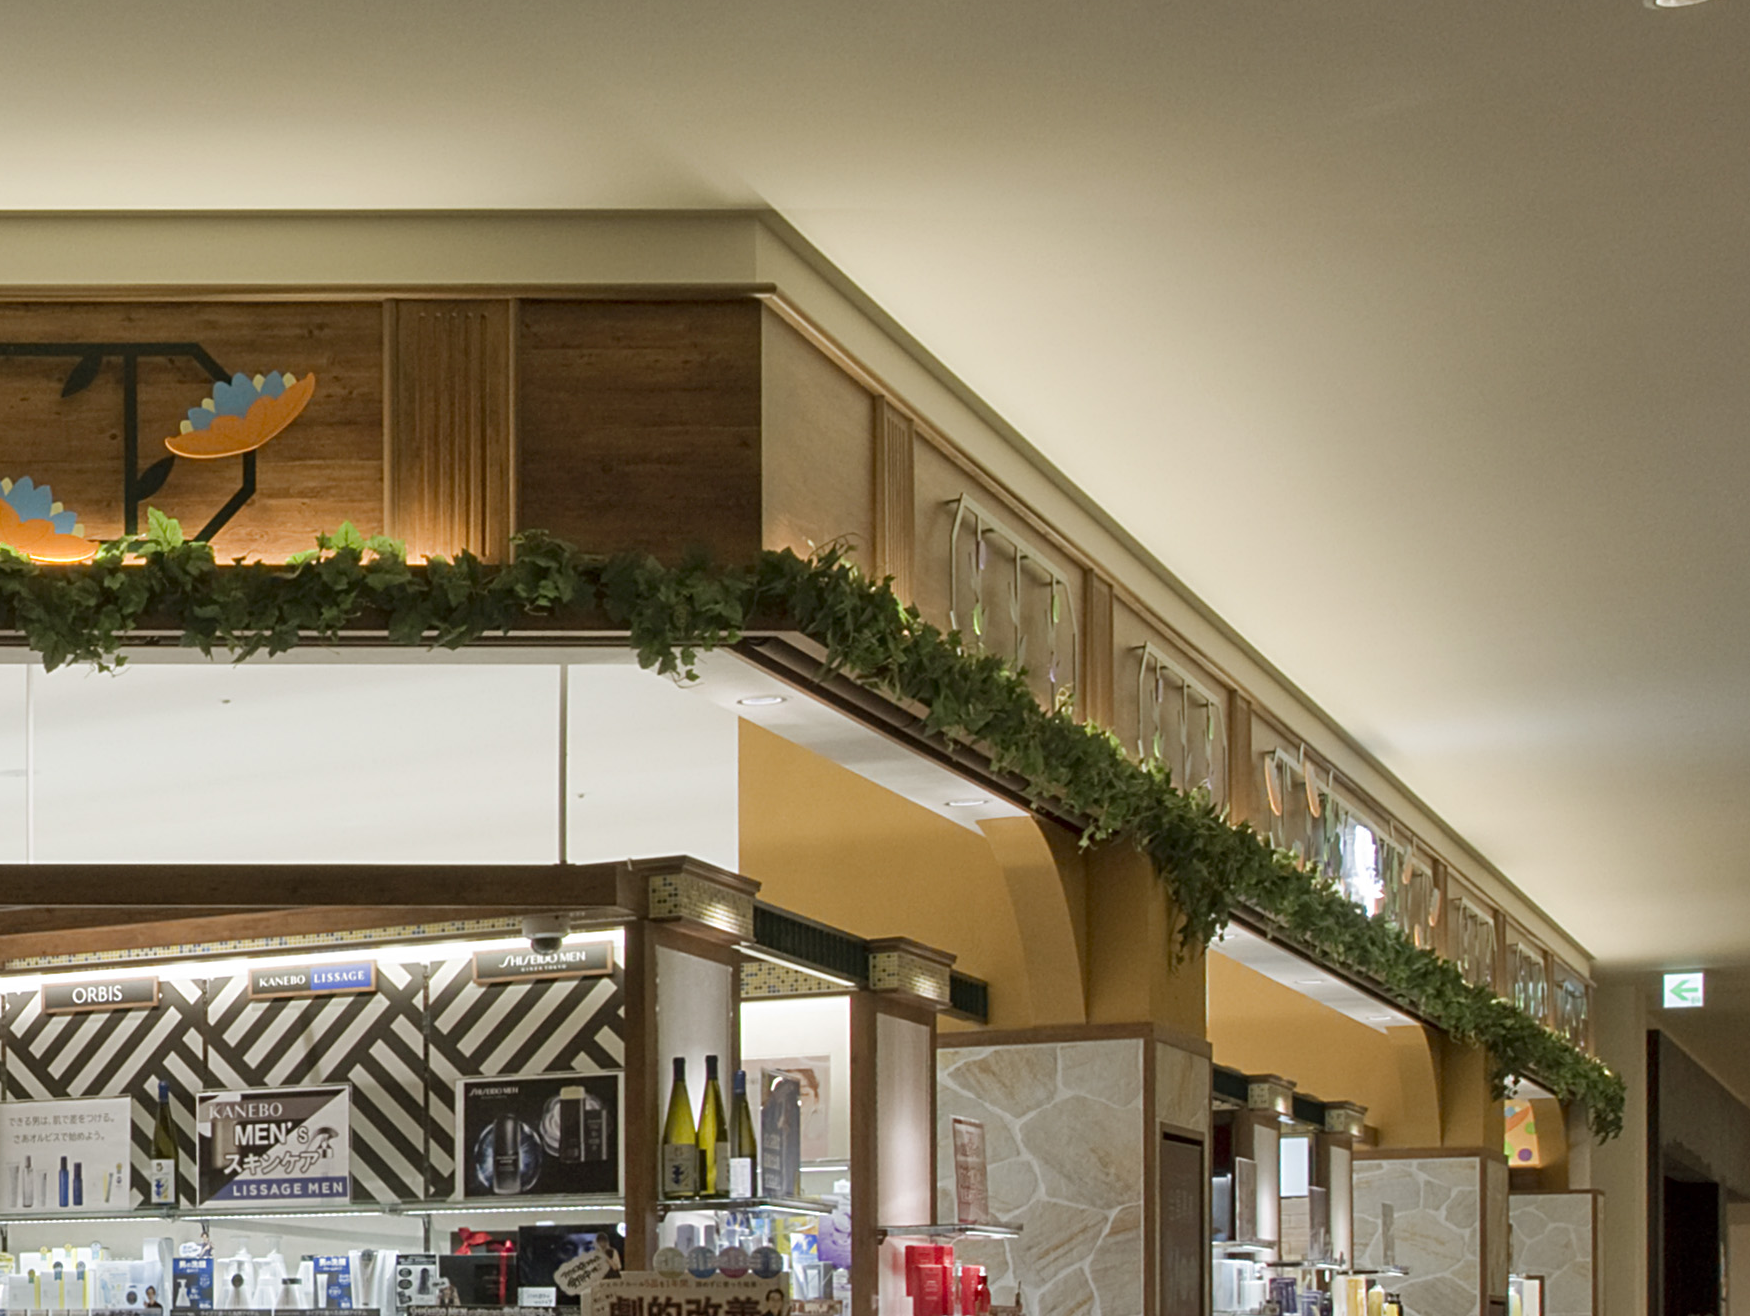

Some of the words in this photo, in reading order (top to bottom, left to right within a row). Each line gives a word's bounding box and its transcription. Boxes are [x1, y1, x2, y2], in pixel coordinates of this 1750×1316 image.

[498, 952, 558, 968] SHISEIDO
[559, 950, 586, 963] MEN
[259, 974, 305, 987] KANEBO
[313, 970, 366, 984] LISSAGE
[72, 984, 123, 1004] ORBIS
[208, 1101, 282, 1120] KANEBO
[234, 1120, 309, 1146] MEN'S
[223, 1151, 322, 1176] スキンケア
[233, 1181, 303, 1196] LISSAGE
[308, 1182, 344, 1194] MEN
